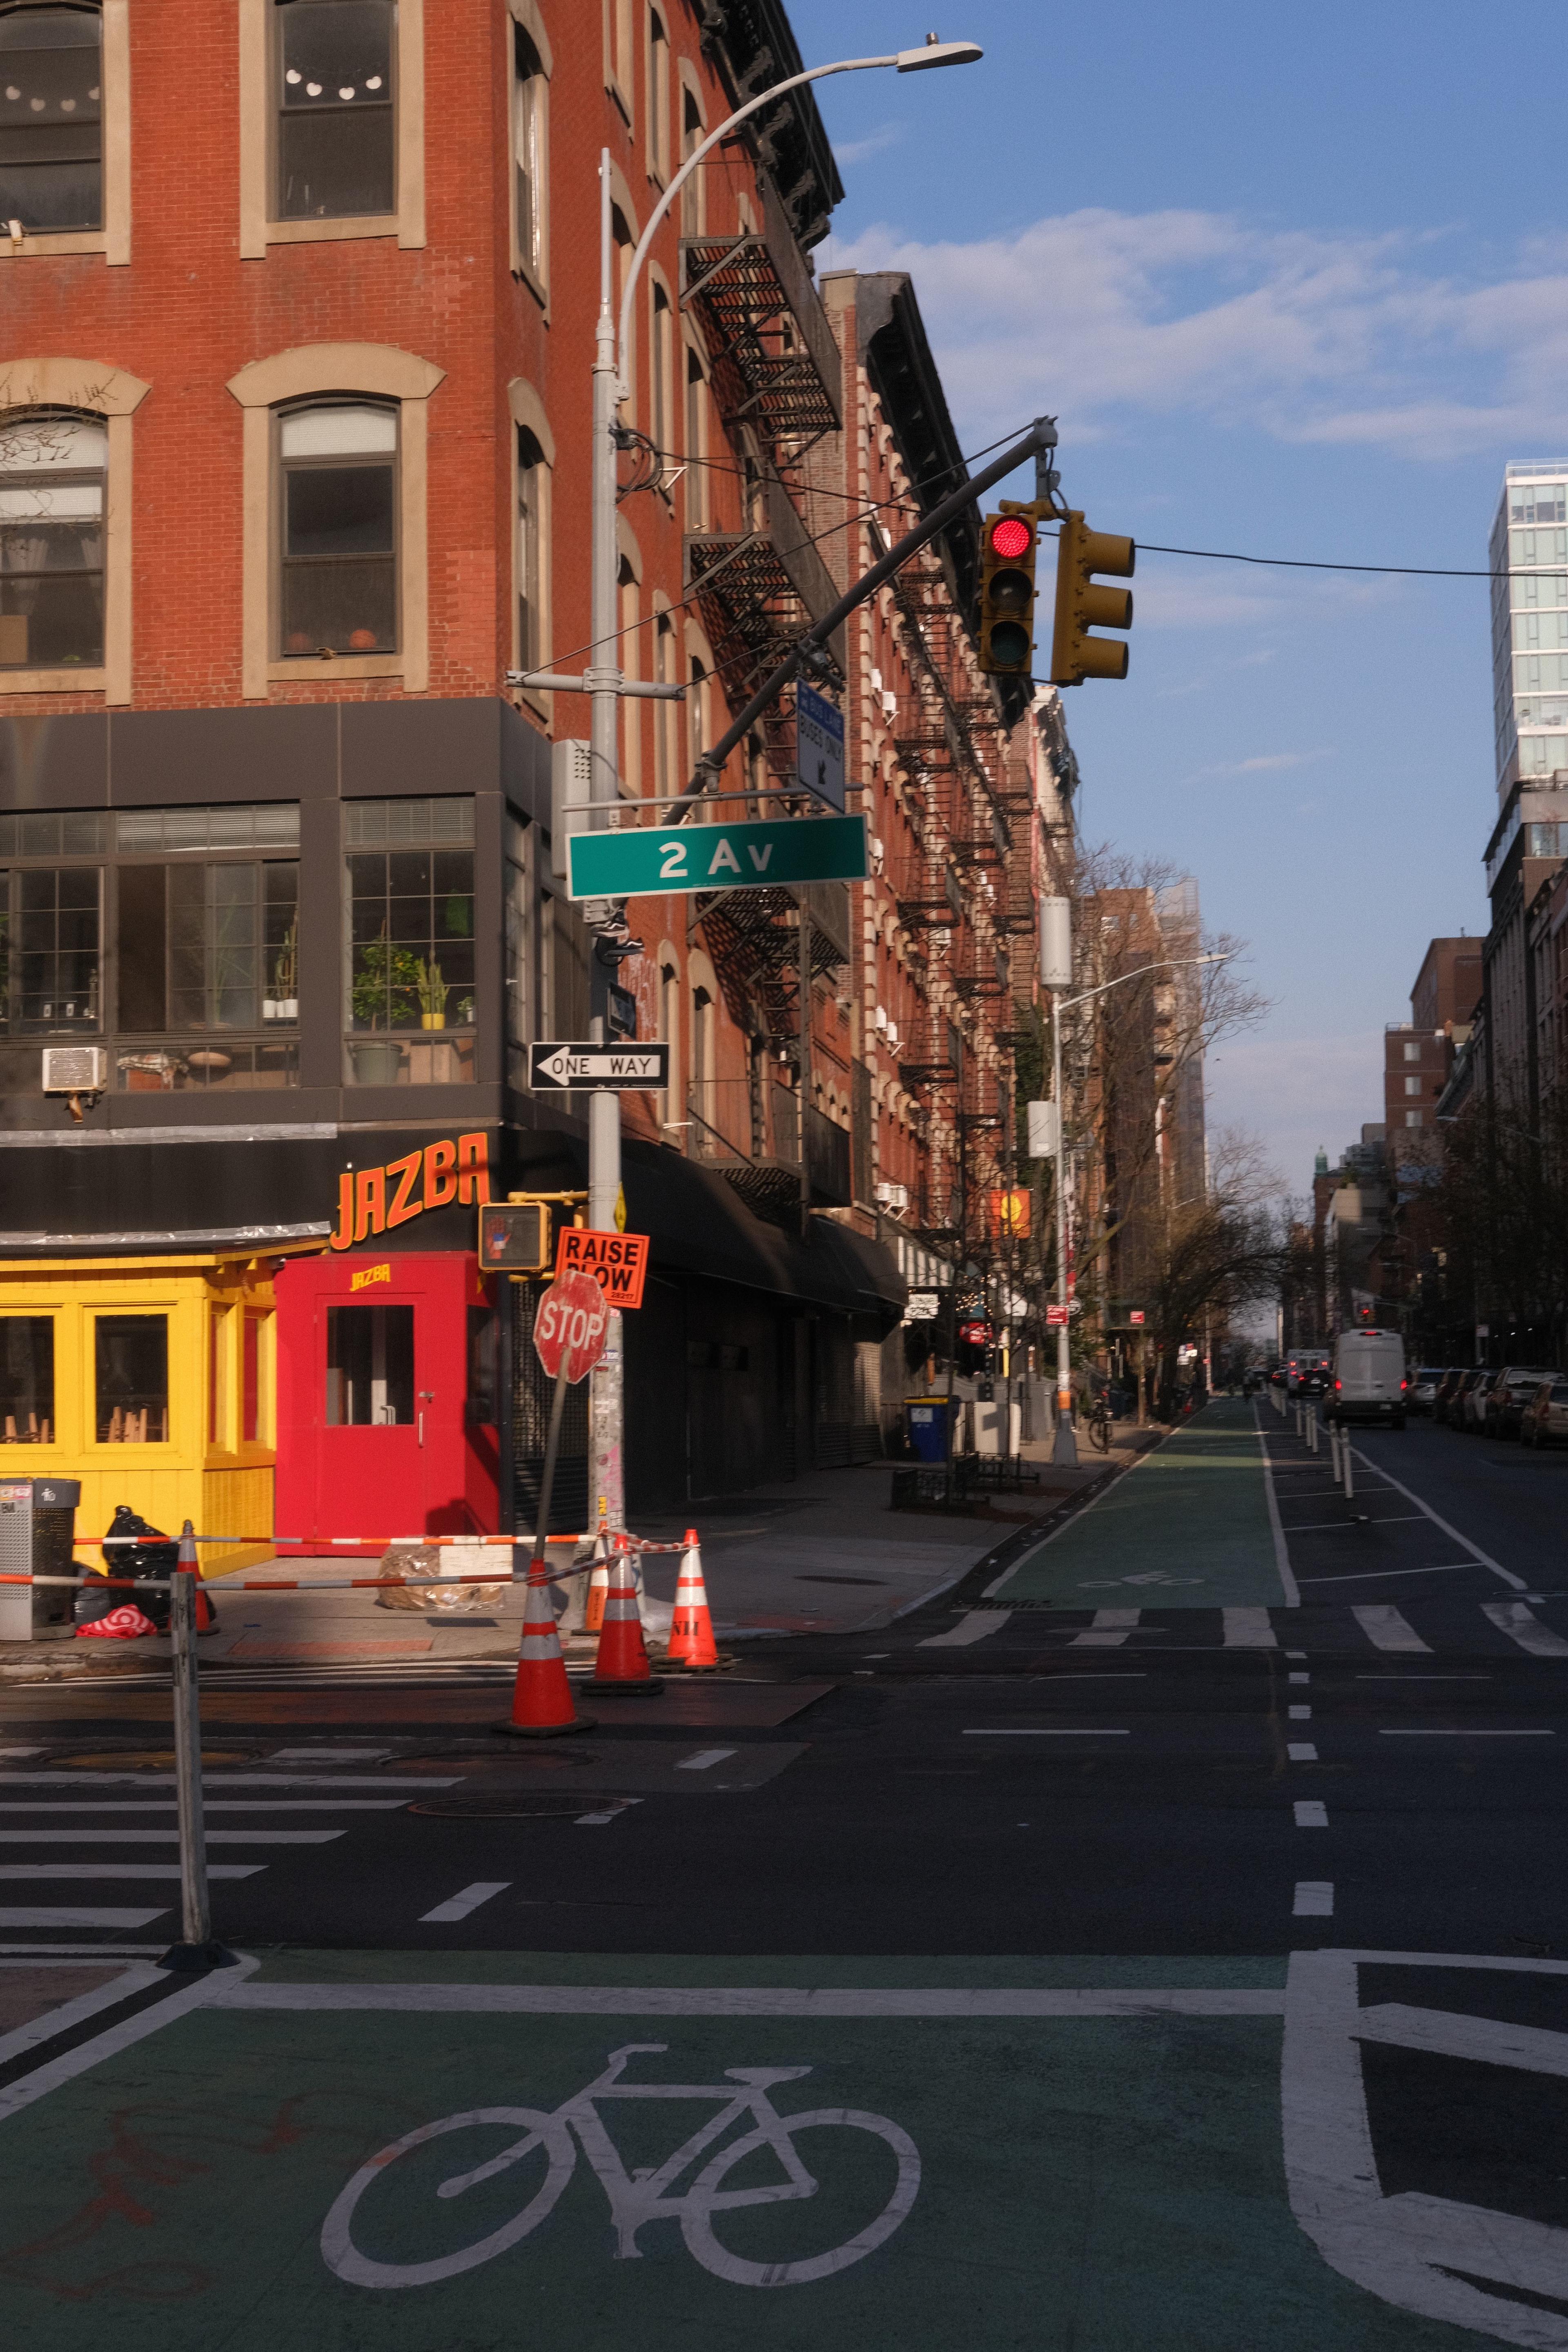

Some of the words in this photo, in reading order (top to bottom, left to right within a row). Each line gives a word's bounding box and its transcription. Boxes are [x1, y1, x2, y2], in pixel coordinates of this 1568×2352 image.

[659, 842, 688, 878] 2
[707, 838, 773, 875] Av
[552, 1058, 590, 1074] ONE
[611, 1058, 651, 1074] WAY
[329, 1132, 490, 1250] JAZBA
[566, 1236, 639, 1266] RAISE
[350, 1263, 391, 1292] JAZBA
[539, 1301, 604, 1350] STOP
